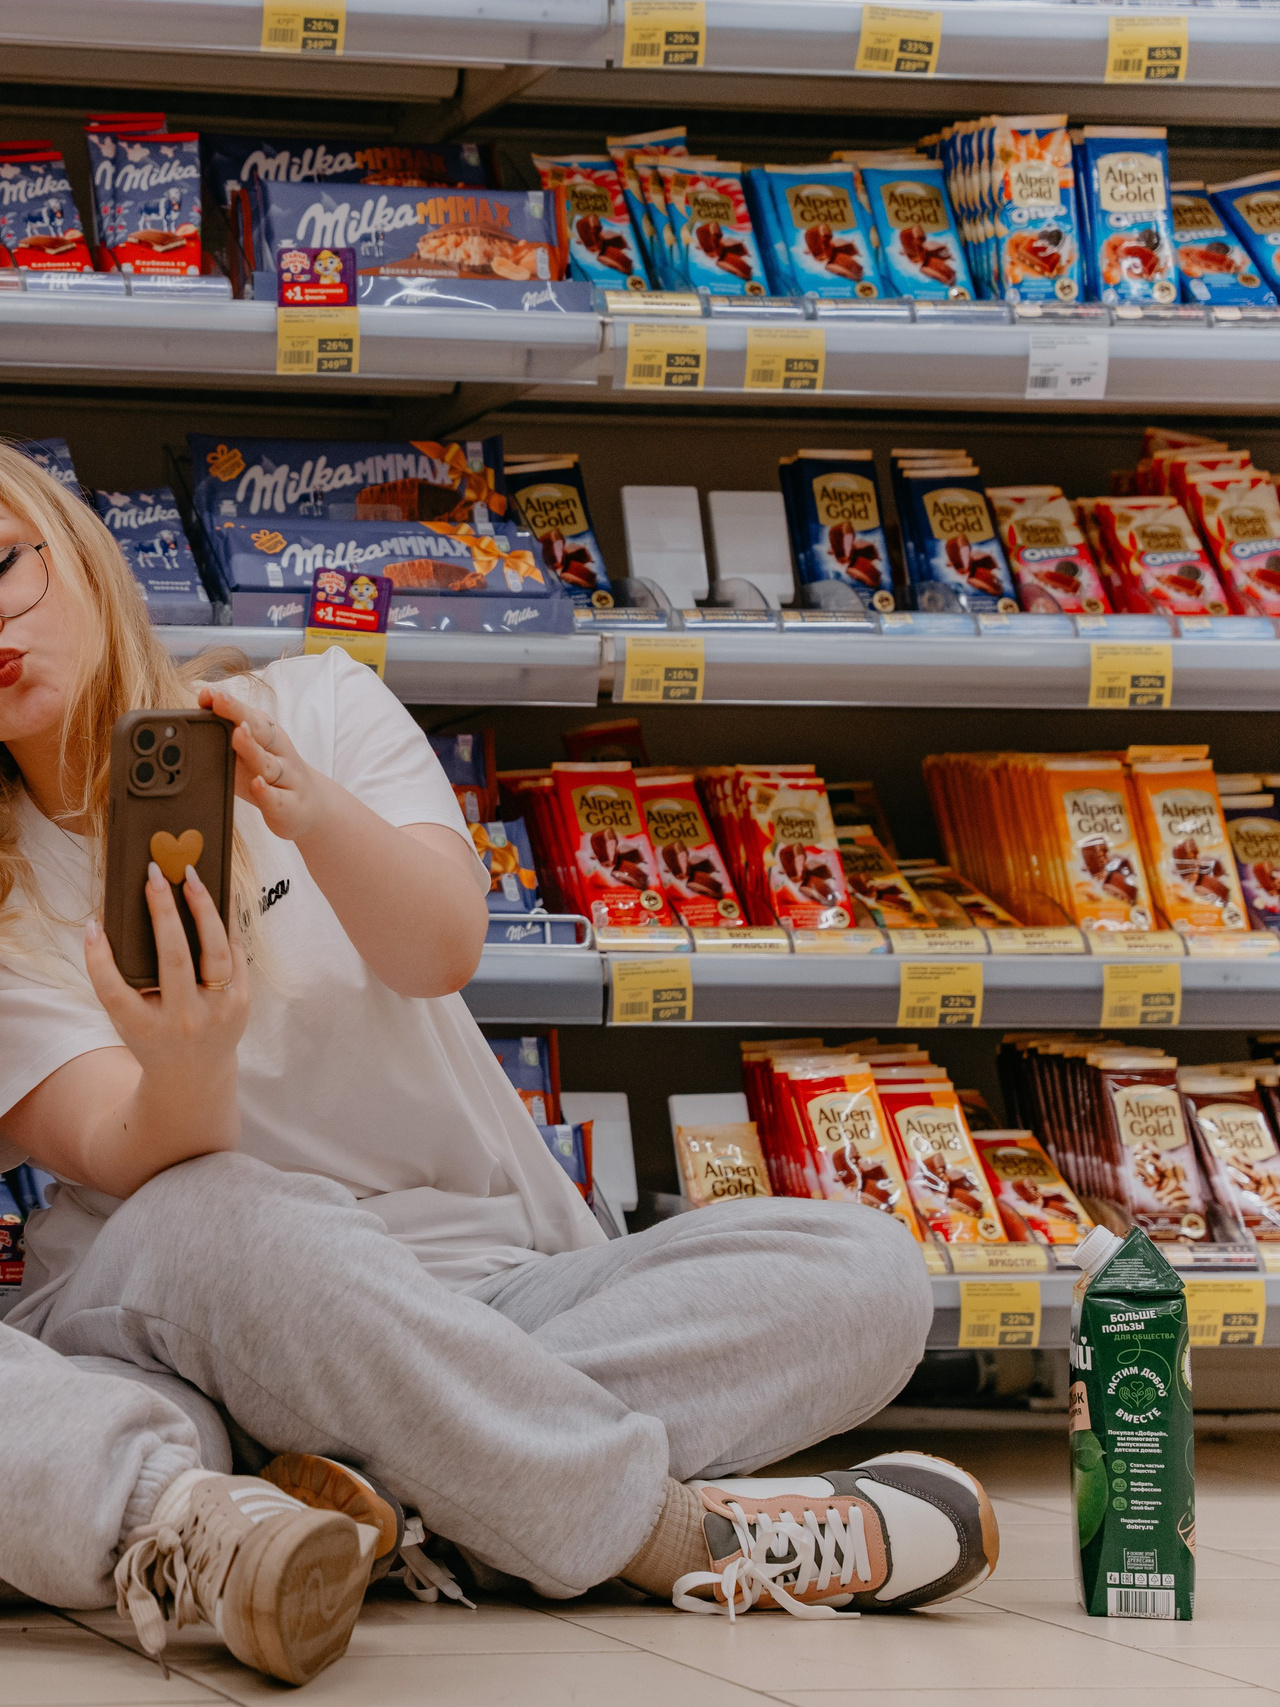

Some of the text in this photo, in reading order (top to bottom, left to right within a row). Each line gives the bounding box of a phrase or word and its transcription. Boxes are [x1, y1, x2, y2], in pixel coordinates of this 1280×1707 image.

[240, 145, 357, 182] Milka
[116, 159, 201, 192] Milka
[1015, 173, 1055, 192] Alpen
[1104, 169, 1159, 187] Alpen
[888, 190, 941, 212] Alpen
[1019, 186, 1053, 201] Gold
[1110, 186, 1156, 203] Gold
[793, 193, 849, 215] Alpen
[296, 195, 511, 248] Milka MMMAX
[800, 207, 846, 223] Gold
[895, 206, 939, 224] Gold
[285, 286, 304, 301] +1
[236, 452, 451, 515] Milka MMMAX
[820, 485, 870, 507] Alpen
[523, 494, 579, 518] Alpen
[826, 503, 869, 521] Gold
[931, 501, 984, 521] Alpen
[104, 504, 181, 529] Milka
[530, 511, 577, 529] Gold
[938, 517, 984, 534] Gold
[281, 531, 472, 575] Milka MMMAX
[317, 606, 335, 621] +1
[578, 796, 632, 816] Alpen
[1070, 800, 1125, 818] Alpen
[1161, 801, 1214, 818] Alpen
[586, 809, 631, 828] Gold
[646, 810, 699, 830] Alpen
[775, 813, 816, 832] Alpen
[1078, 817, 1122, 834] Gold
[1168, 818, 1212, 835] Gold
[652, 824, 699, 841] Gold
[781, 826, 814, 840] Gold
[818, 1106, 871, 1124] Alpen
[1123, 1100, 1177, 1119] Alpen
[826, 1121, 871, 1141] Gold
[906, 1119, 959, 1136] Alpen
[1130, 1119, 1175, 1138] Gold
[705, 1161, 759, 1182] Alpen
[711, 1179, 757, 1197] Gold
[1110, 1310, 1157, 1323] БОЛЬШЕ
[1102, 1322, 1145, 1333] ПОЛЬЗЫ
[1113, 1333, 1176, 1341] ДЛЯ ОБЩЕСТВА
[1107, 1366, 1168, 1398] РАСТИМ ДОБРО
[1115, 1407, 1162, 1424] ВМЕСТЕ
[1126, 1523, 1154, 1531] dobry.ru
